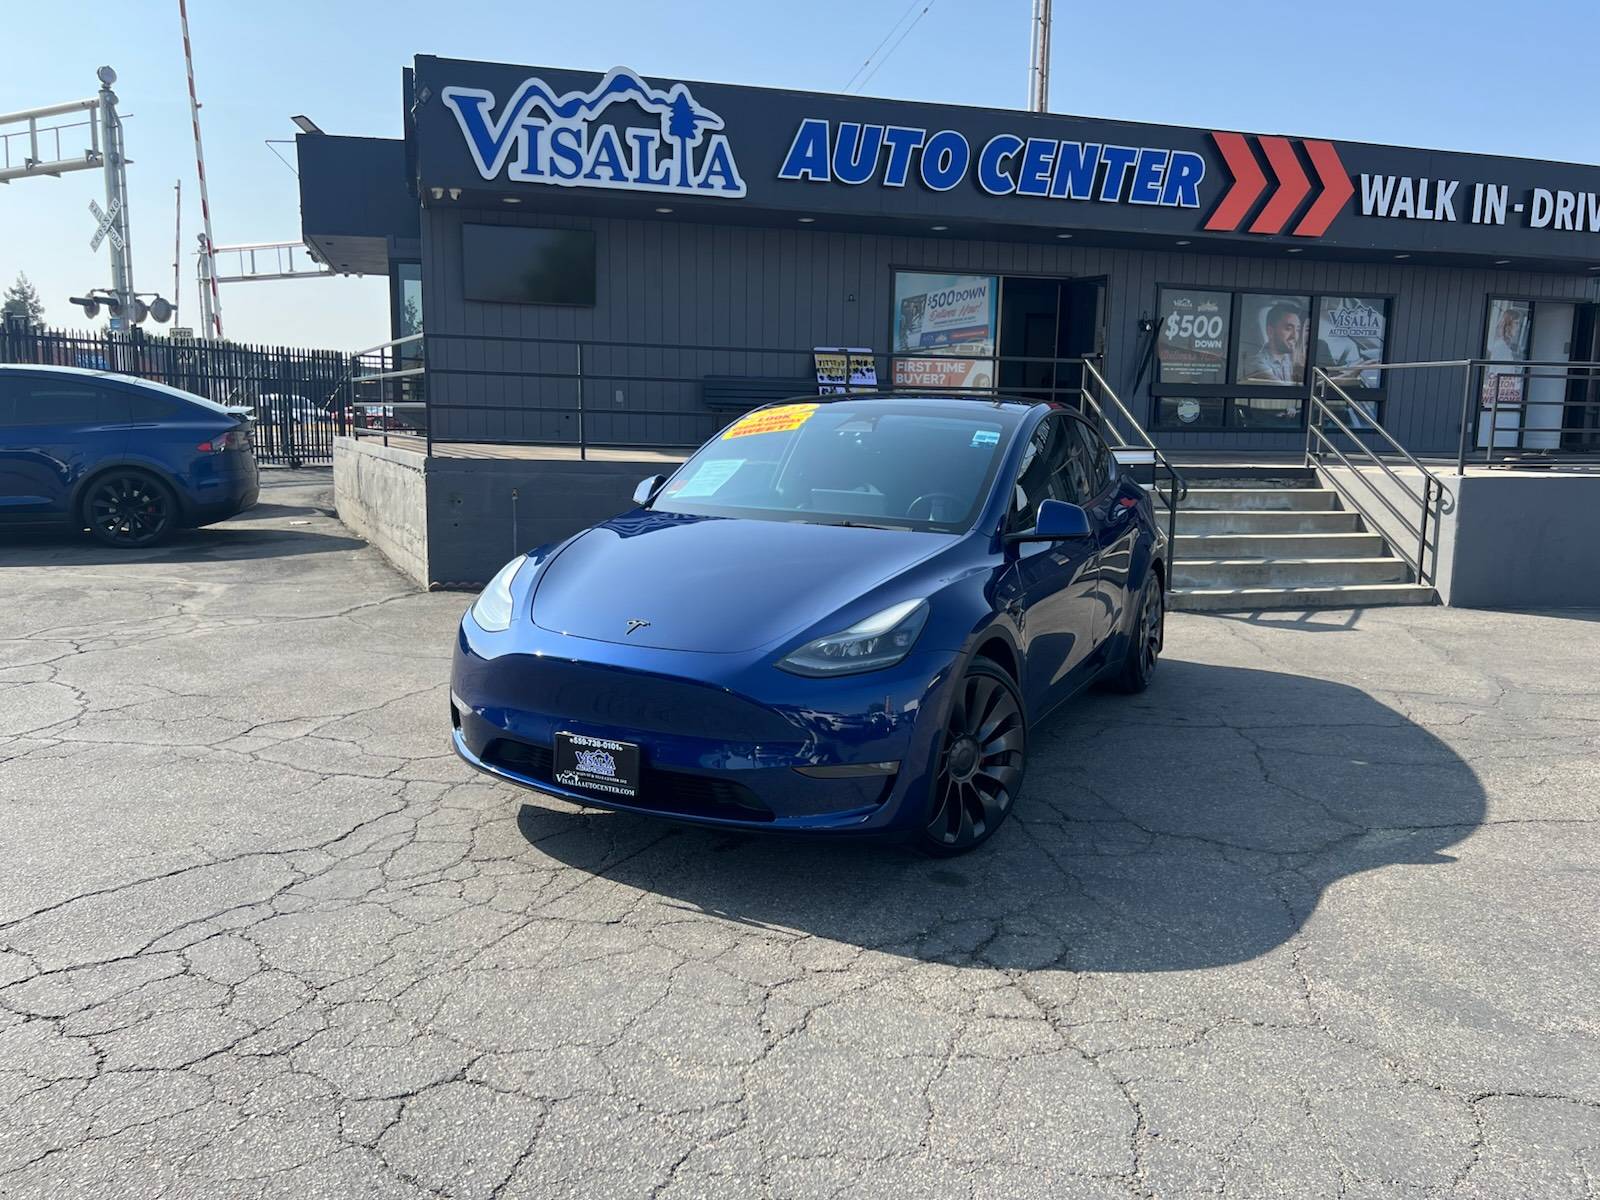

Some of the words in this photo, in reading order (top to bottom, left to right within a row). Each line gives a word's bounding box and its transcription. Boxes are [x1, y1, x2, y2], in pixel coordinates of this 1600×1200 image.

[443, 85, 747, 198] VISALIA
[778, 118, 970, 191] AUTO
[978, 134, 1205, 208] CENTER
[1361, 173, 1460, 222] WALK
[1472, 183, 1509, 225] IN
[928, 289, 956, 309] $500
[956, 286, 987, 302] DOWN
[1165, 311, 1223, 340] $500
[1329, 307, 1380, 327] VISALIA
[1328, 328, 1348, 336] AUTO
[1195, 340, 1222, 348] DOWN
[896, 361, 932, 372] FIRST
[935, 361, 966, 373] TIME
[895, 373, 946, 384] BUYER?
[1488, 380, 1515, 388] UION
